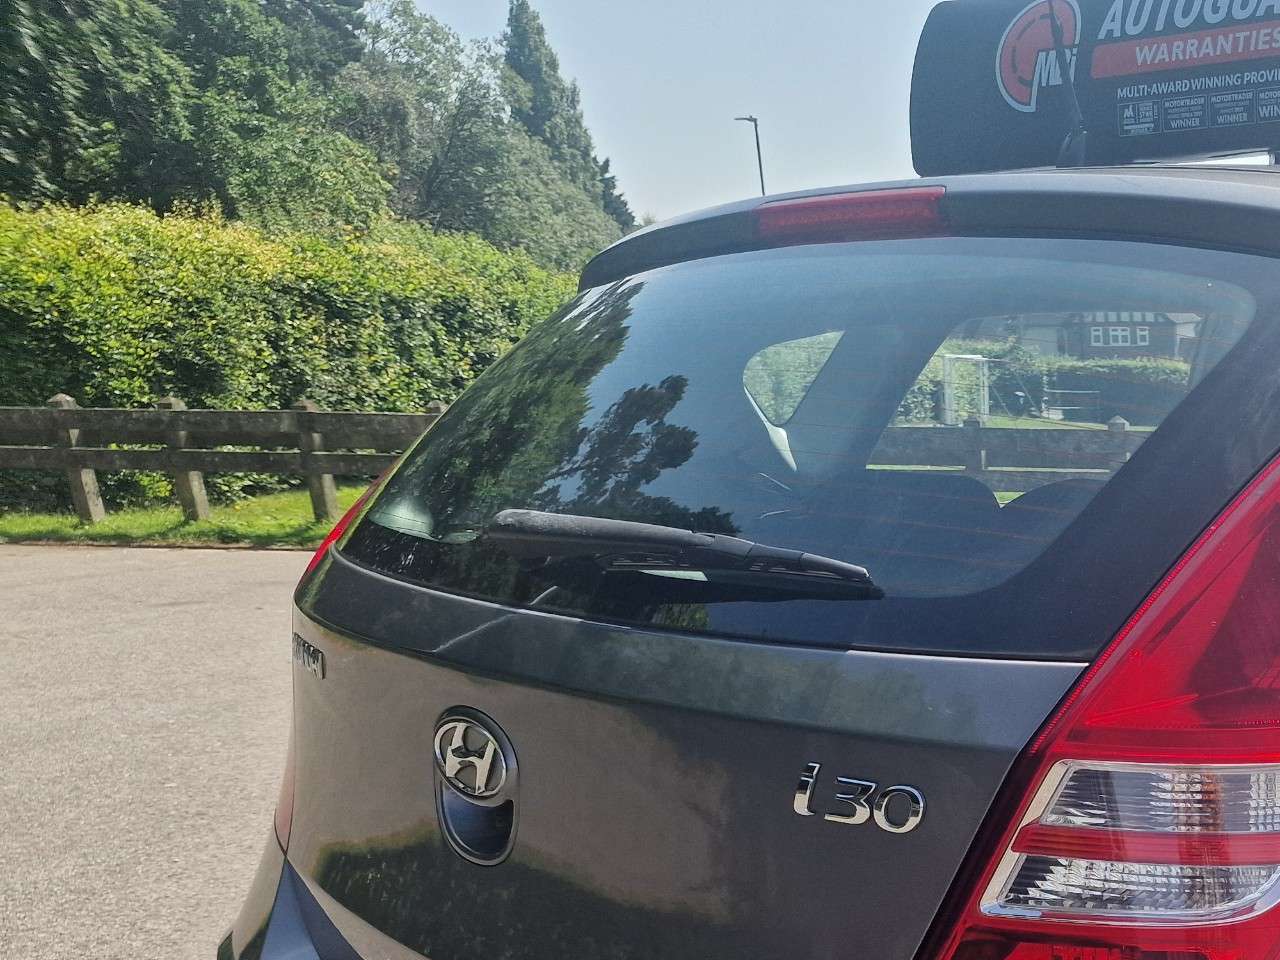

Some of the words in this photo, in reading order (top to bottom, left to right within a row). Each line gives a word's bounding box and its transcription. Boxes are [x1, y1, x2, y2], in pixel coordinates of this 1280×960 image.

[1117, 80, 1190, 99] MULTI-AWARD
[1191, 73, 1242, 91] WINNING
[1170, 117, 1200, 129] WINNER
[1216, 112, 1248, 124] WINNER
[793, 761, 926, 834] i30
